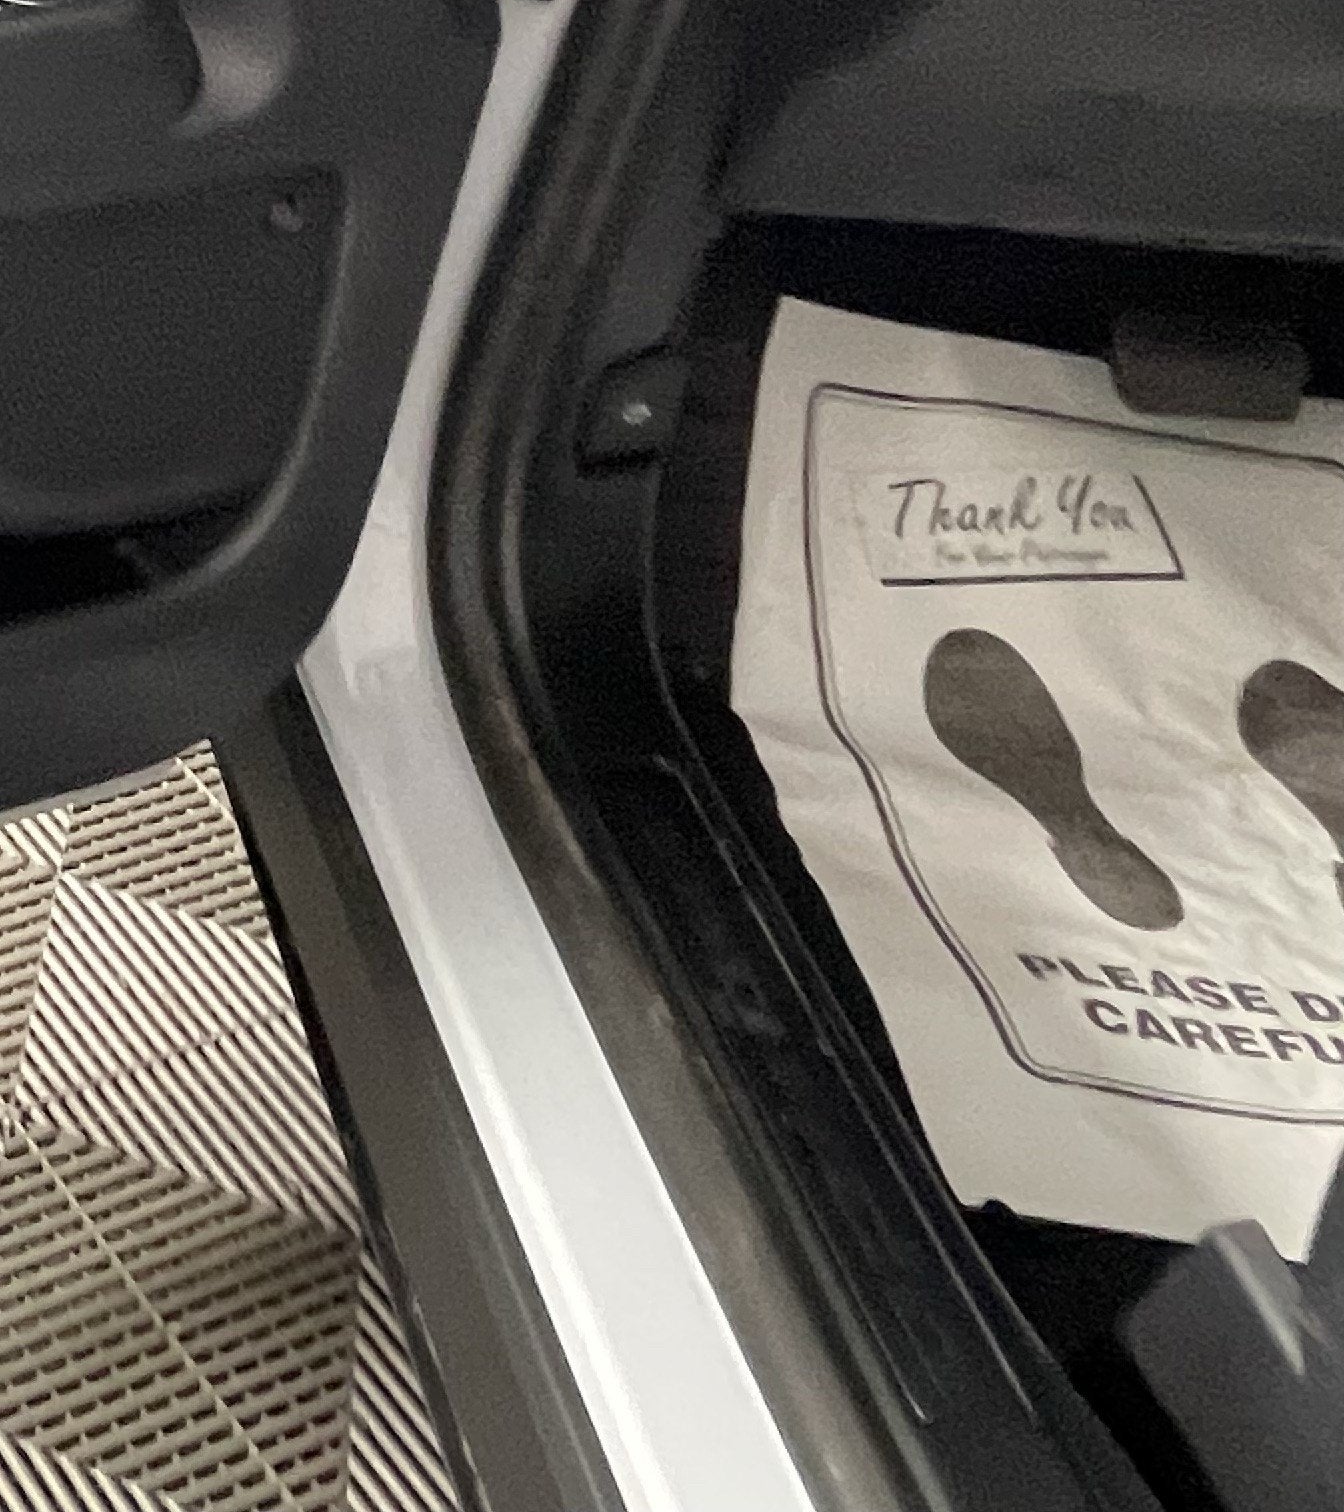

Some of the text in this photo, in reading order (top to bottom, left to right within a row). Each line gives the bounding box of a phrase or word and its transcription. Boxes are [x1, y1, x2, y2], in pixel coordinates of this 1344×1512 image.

[887, 474, 1135, 539] Thank You
[1017, 952, 1344, 1022] PLEASE D
